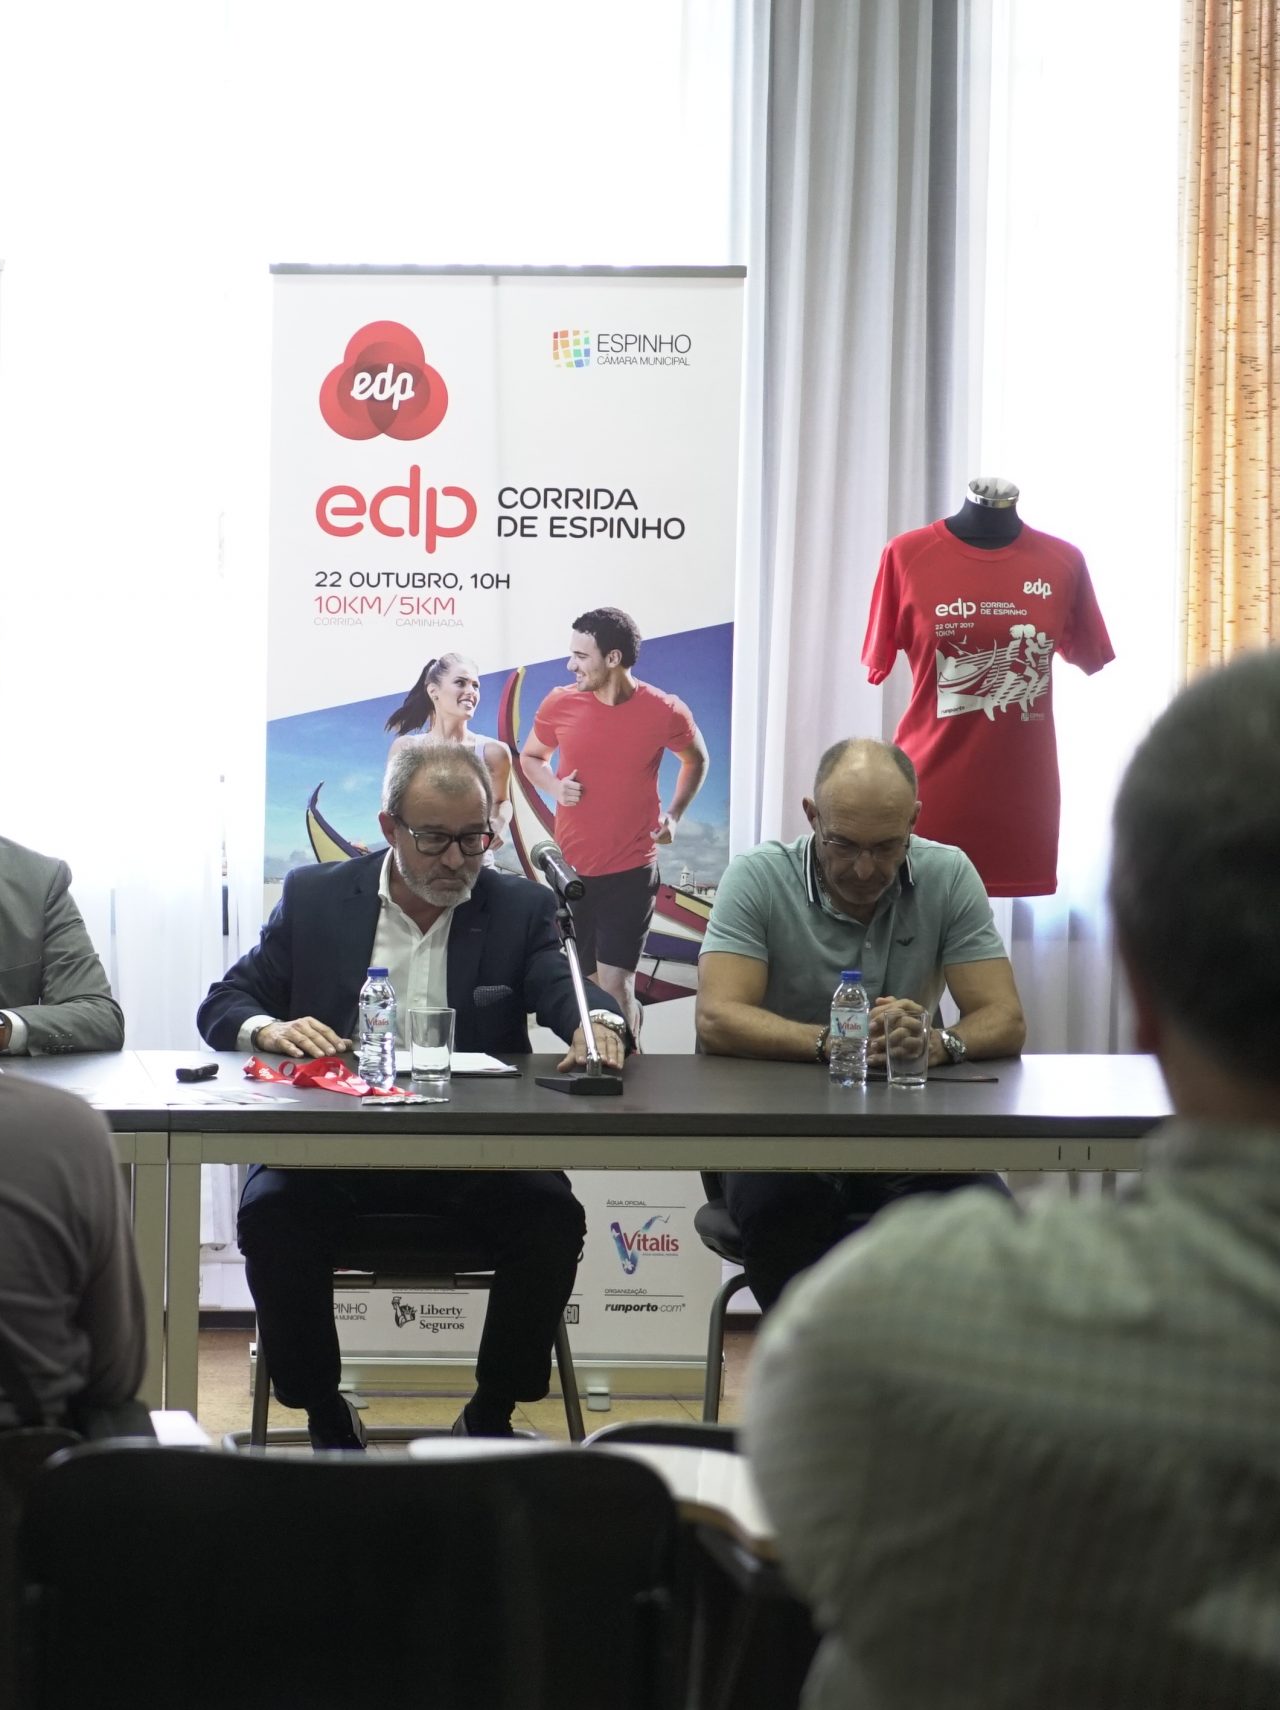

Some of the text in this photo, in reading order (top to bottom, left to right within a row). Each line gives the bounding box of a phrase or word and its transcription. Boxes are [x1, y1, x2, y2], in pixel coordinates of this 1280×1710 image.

[597, 333, 692, 354] ESPINHO
[596, 353, 691, 366] CÂMARA MUNICIPAL
[350, 363, 415, 411] edp
[315, 464, 478, 554] edp
[497, 486, 639, 511] CORRIDA
[497, 516, 686, 540] DE ESPINHO
[314, 571, 510, 591] 22 OUTUBRO, 10H
[1023, 578, 1052, 600] edp
[935, 598, 976, 619] edp
[313, 617, 363, 627] CORRIDA
[395, 618, 464, 628] CAMINHADA
[623, 1229, 679, 1252] Vitalis
[604, 1288, 648, 1296] ORGANIZAÇÃO
[420, 1304, 463, 1319] Liberty
[419, 1320, 465, 1333] Seguros
